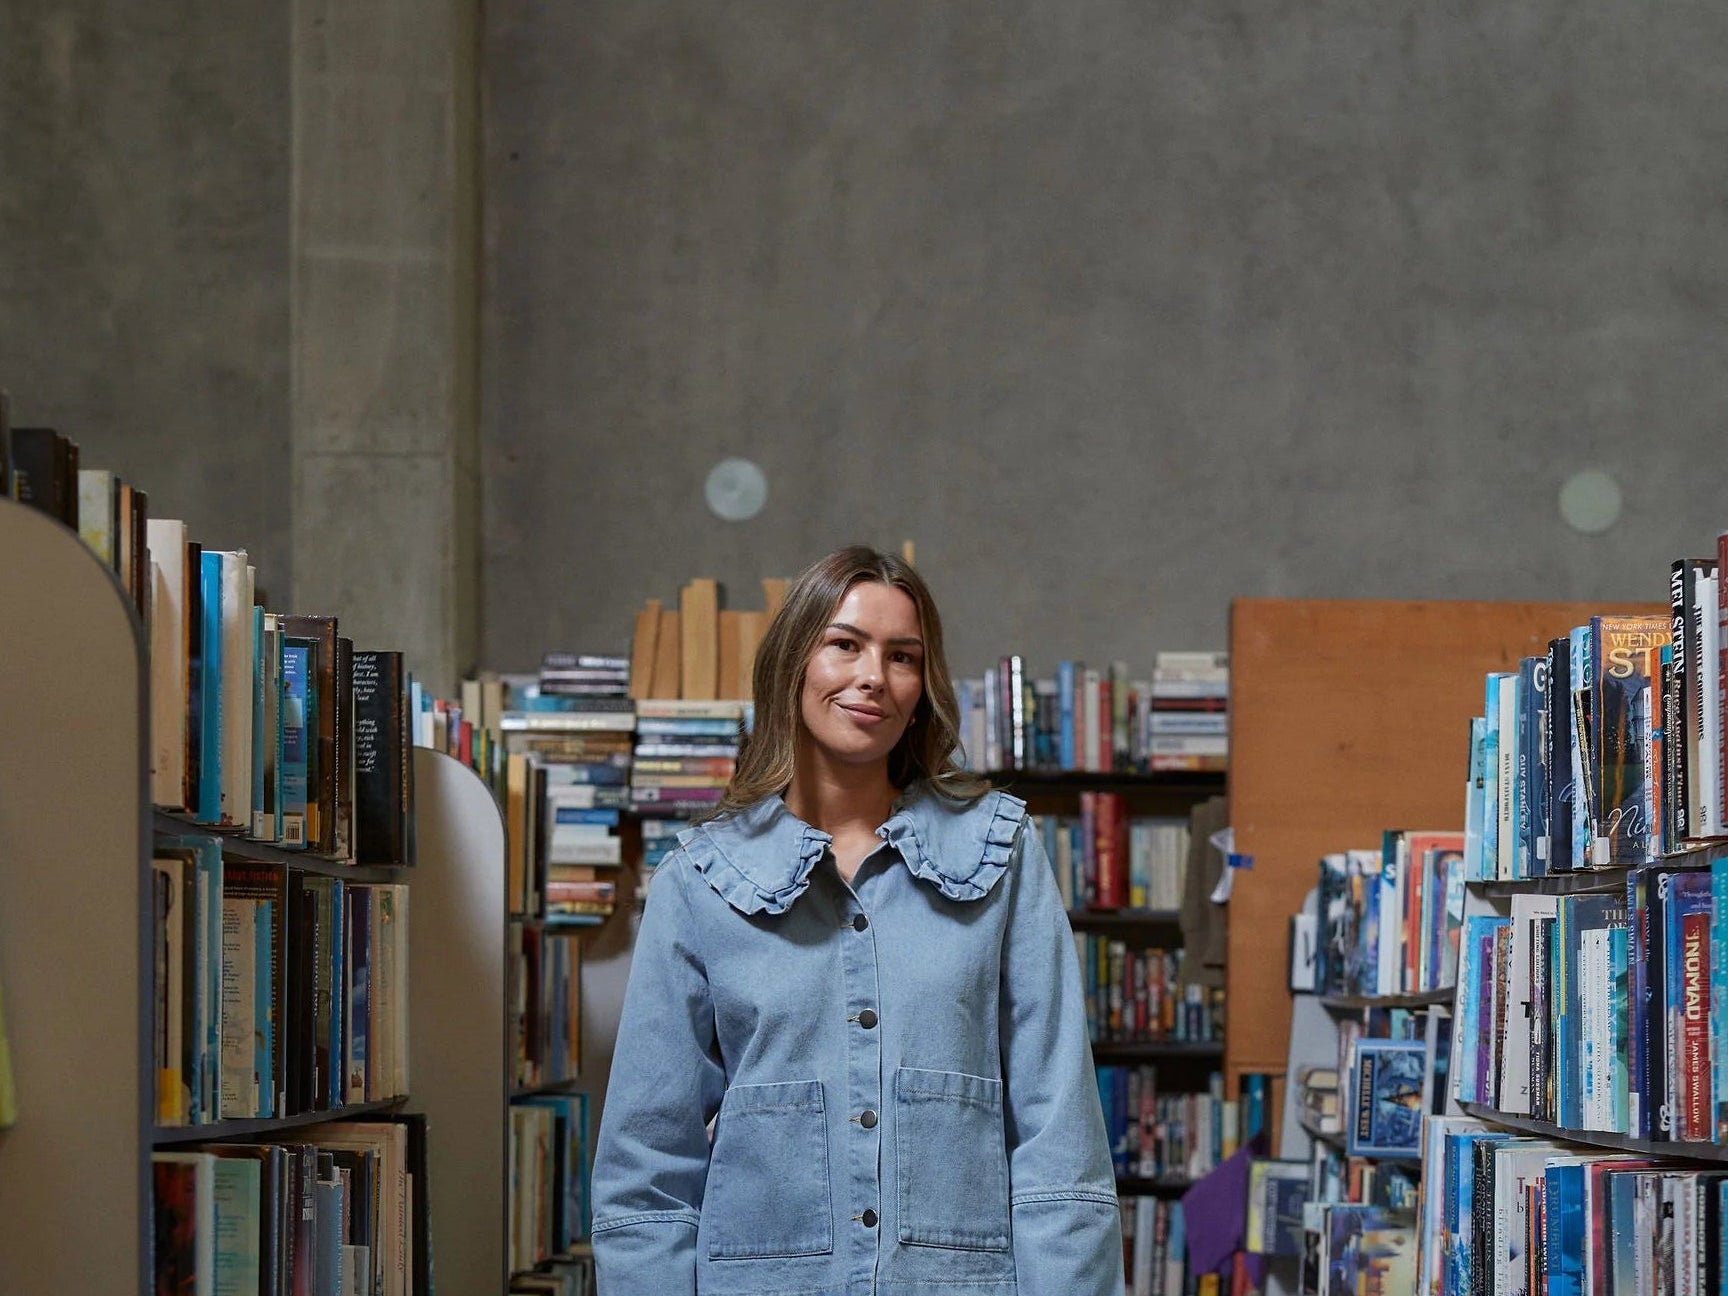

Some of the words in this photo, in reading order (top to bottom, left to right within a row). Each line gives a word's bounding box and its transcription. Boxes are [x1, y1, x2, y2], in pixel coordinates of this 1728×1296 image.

[1602, 623, 1620, 631] NEW
[1623, 623, 1641, 631] YORK
[1645, 622, 1667, 630] TIMES
[1671, 616, 1685, 674] STEIN
[1686, 942, 1702, 1021] NOMAD
[1692, 1040, 1700, 1073] JAMES
[1360, 1109, 1370, 1137] WEST
[1692, 1076, 1700, 1123] SWALLOW
[1549, 1181, 1560, 1271] DRUMBEAT
